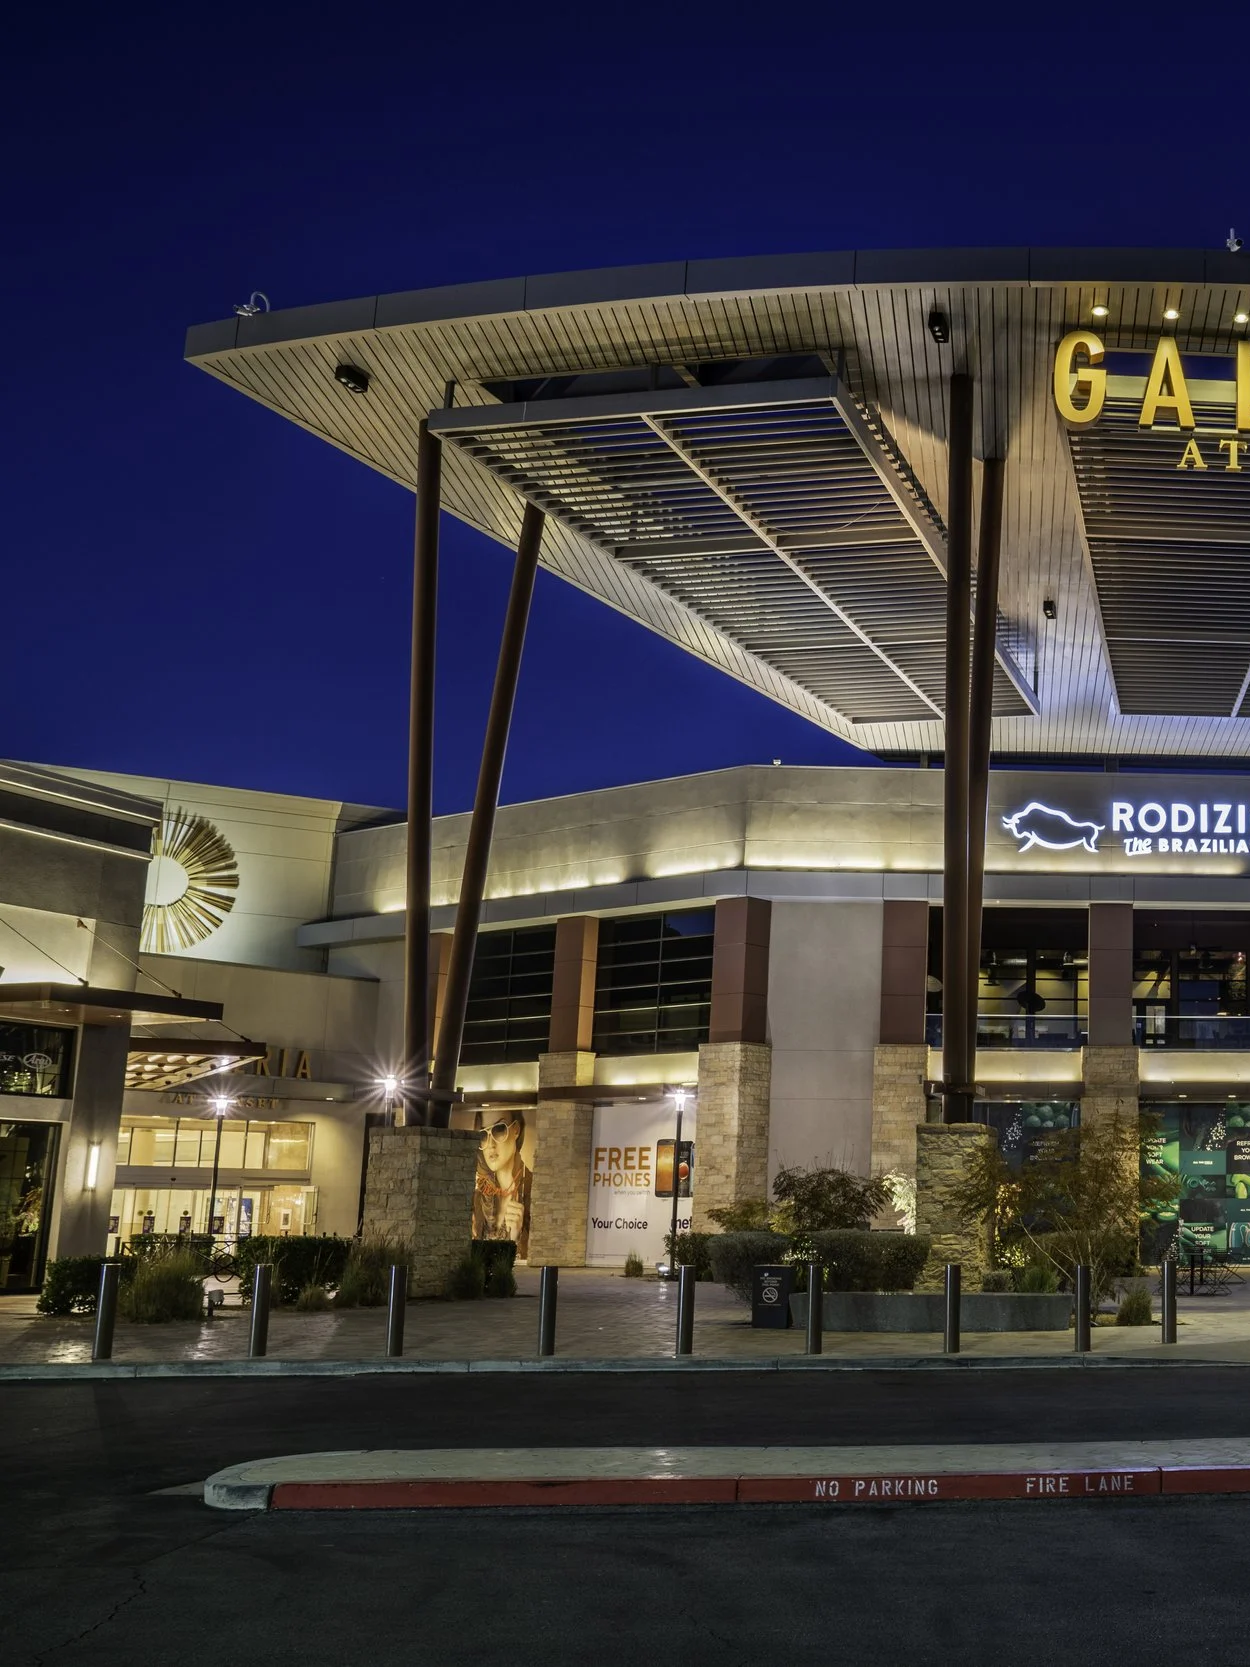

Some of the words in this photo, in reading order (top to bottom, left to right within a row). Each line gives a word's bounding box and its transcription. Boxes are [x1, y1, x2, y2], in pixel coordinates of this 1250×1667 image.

[1176, 438, 1248, 472] AT
[1124, 837, 1152, 857] The
[593, 1147, 652, 1171] FREE
[593, 1172, 651, 1188] PHONES
[592, 1217, 613, 1229] Your
[615, 1217, 648, 1230] Choice
[815, 1480, 840, 1497] NO
[854, 1479, 938, 1497] PARKING
[1026, 1477, 1069, 1493] FIRE
[1085, 1475, 1134, 1492] LANE
